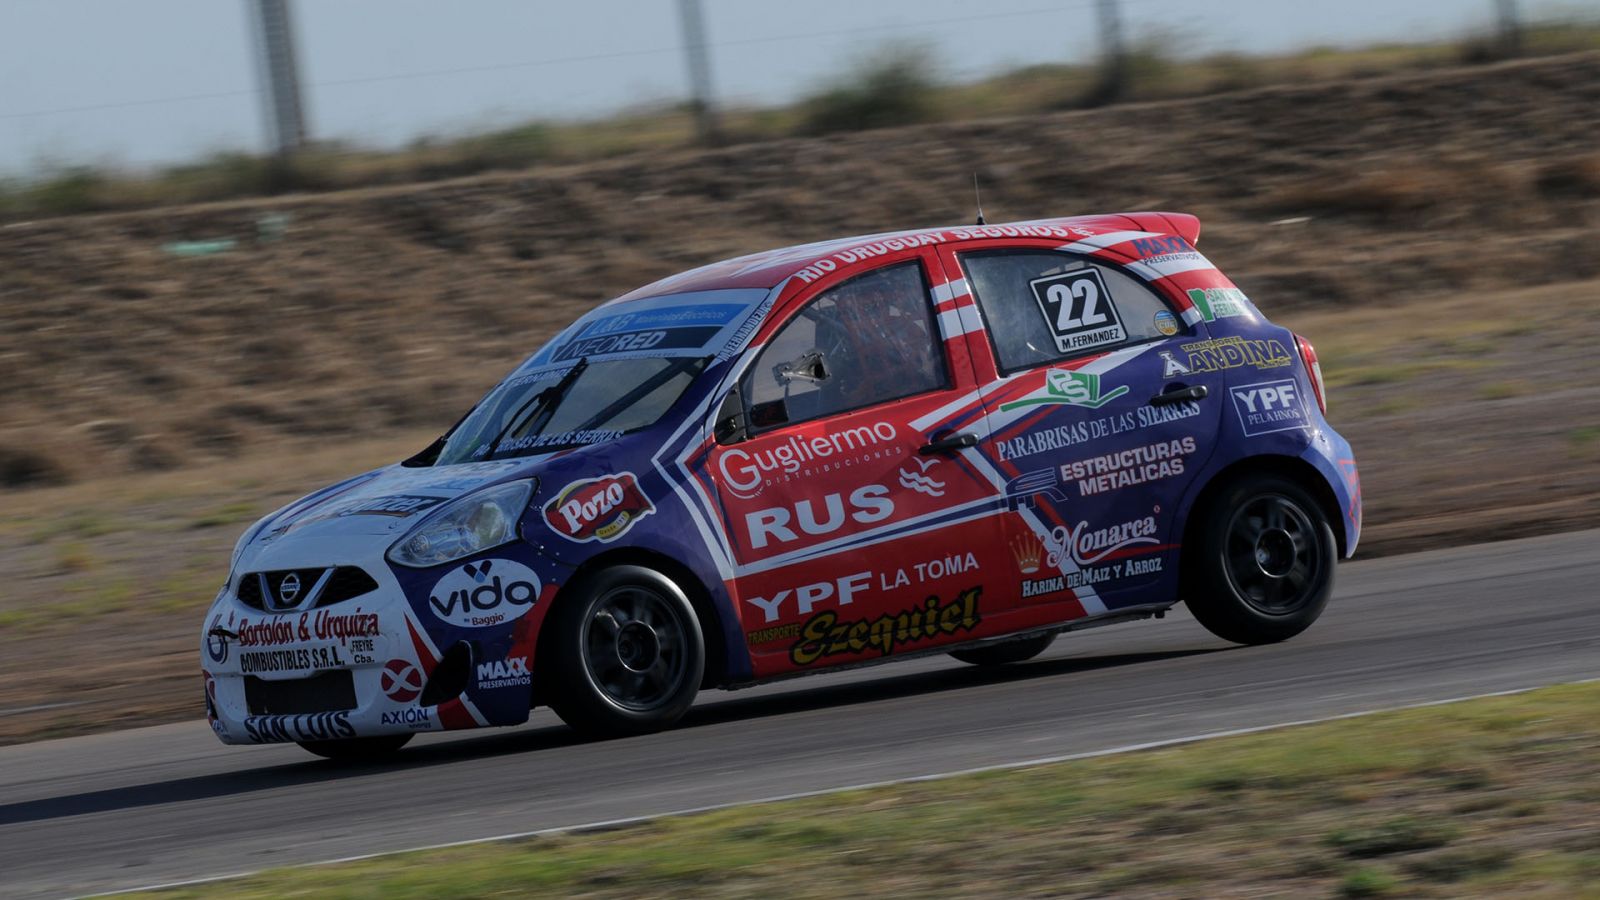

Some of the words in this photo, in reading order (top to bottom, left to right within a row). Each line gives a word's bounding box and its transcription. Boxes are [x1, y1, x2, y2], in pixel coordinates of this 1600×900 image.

[795, 259, 836, 284] RIO
[835, 232, 947, 263] URUGUAY
[950, 226, 1069, 240] SEGUROS
[1046, 279, 1107, 331] 22
[1062, 328, 1120, 350] M.FERNANDEZ
[1182, 337, 1242, 351] TRANSPORTE
[1188, 340, 1291, 372] ANDINA
[1234, 385, 1295, 413] YPF
[996, 422, 1089, 462] PARABRISAS
[1090, 418, 1109, 440] DE
[1110, 411, 1136, 434] LAS
[719, 422, 896, 491] Gugliermo
[766, 447, 902, 487] DISTRIBUCIONES
[1060, 437, 1197, 482] ESTRUCTURAS
[1079, 458, 1185, 496] METALICAS
[745, 485, 895, 549] RUS
[1047, 516, 1161, 568] Monarca
[1113, 565, 1122, 578] Y
[431, 575, 537, 617] vida
[747, 571, 873, 624] YPF
[880, 568, 910, 591] LA
[914, 552, 980, 583] TOMA
[298, 611, 311, 641] &
[472, 613, 505, 626] Baggio
[748, 623, 801, 645] TRANSPORTE
[791, 587, 982, 664] Ezequiel
[240, 648, 311, 673] COMBUSTIBLES
[312, 645, 345, 669] S.R.L.
[352, 639, 374, 653] FREYRE
[353, 654, 375, 664] Cba.
[478, 656, 532, 681] MAXX
[478, 676, 531, 690] PRESERVATIVOS
[244, 714, 297, 743] SAN
[294, 710, 357, 742] LUIS
